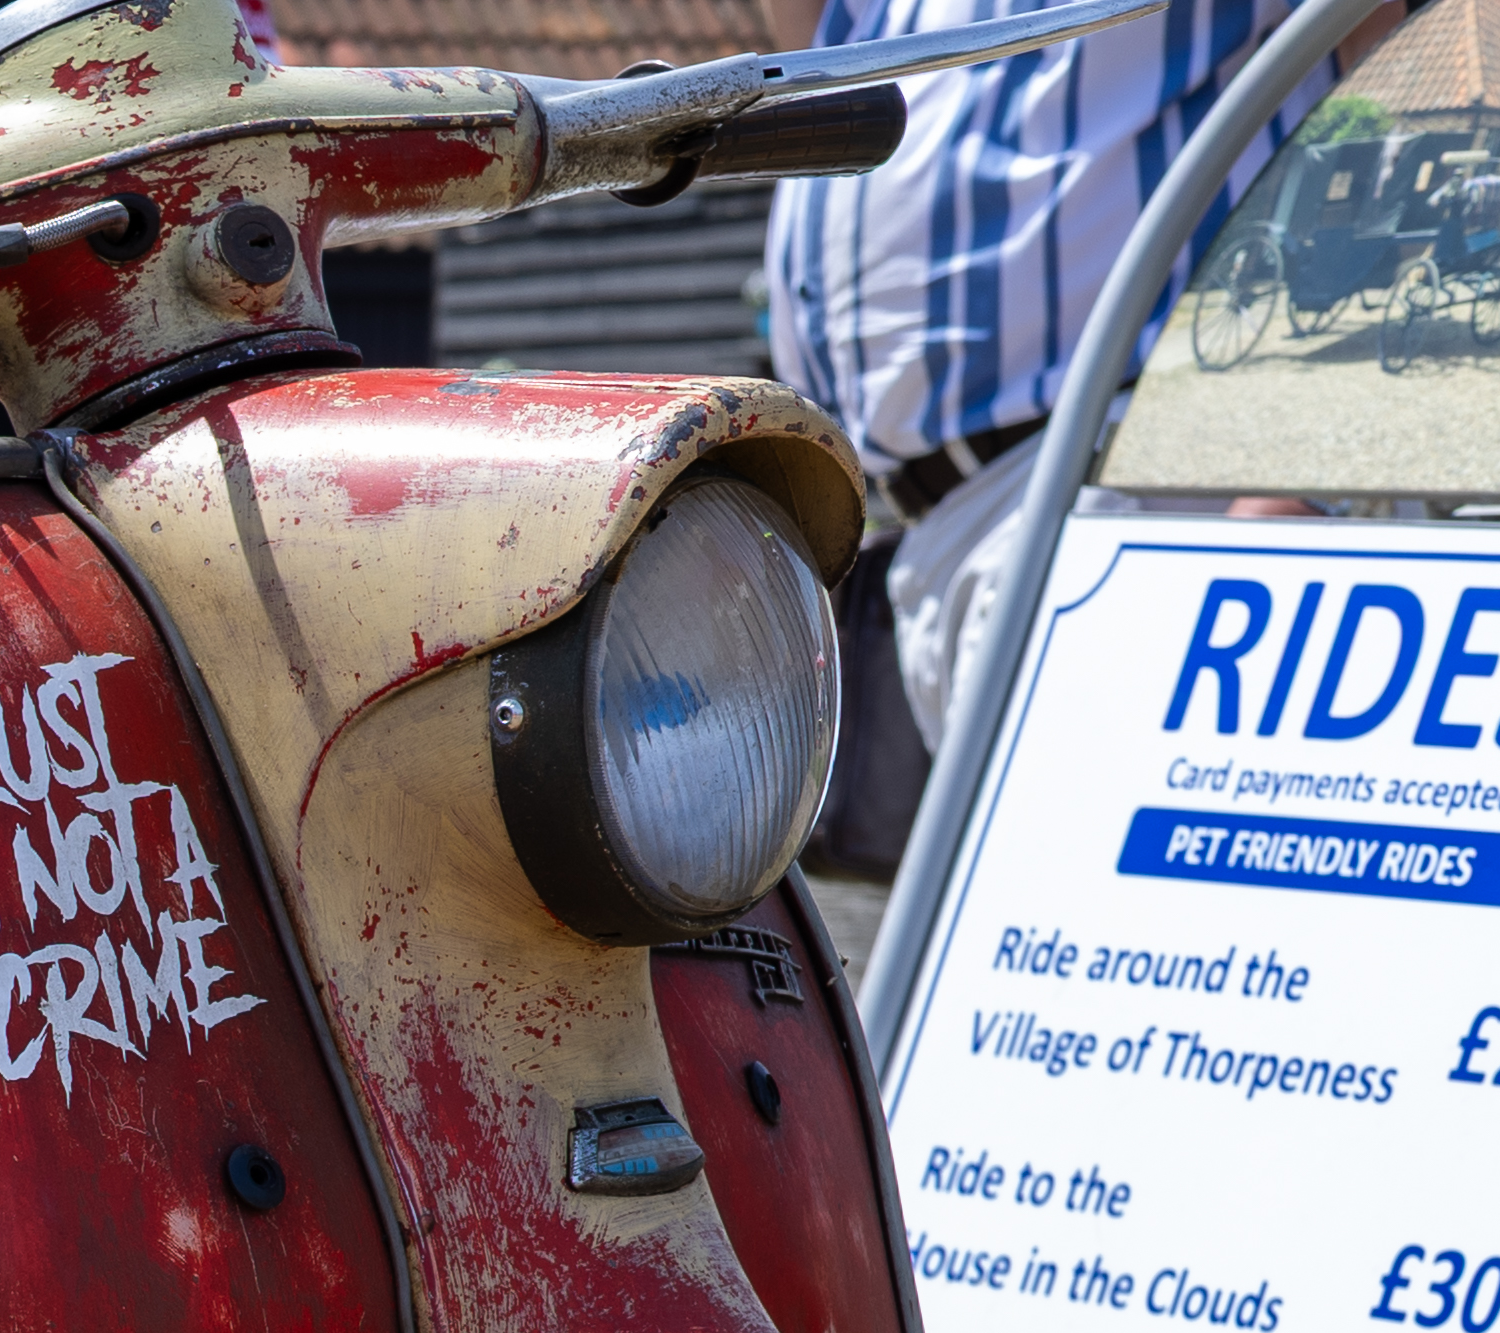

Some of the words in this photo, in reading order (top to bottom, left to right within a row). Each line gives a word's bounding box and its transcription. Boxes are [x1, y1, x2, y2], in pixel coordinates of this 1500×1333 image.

[1162, 578, 1500, 751] RIDE
[1166, 757, 1233, 796] Card
[1232, 767, 1377, 805] payments
[12, 780, 175, 950] NOT
[164, 783, 227, 925] A
[1165, 825, 1220, 868] PET
[1227, 829, 1379, 882] FRIENDLY
[1378, 839, 1477, 888] RIDES
[993, 927, 1079, 980] Ride
[1087, 945, 1237, 995] around
[1241, 953, 1311, 1004] the
[970, 1010, 1097, 1077] Village
[1107, 1027, 1154, 1075] of
[1165, 1031, 1398, 1104] Thorpeness
[920, 1145, 1005, 1200] Ride
[1014, 1161, 1057, 1209] to
[1064, 1165, 1133, 1219] the
[1019, 1246, 1058, 1297] in
[1067, 1255, 1135, 1313] the
[1145, 1267, 1285, 1333] Clouds
